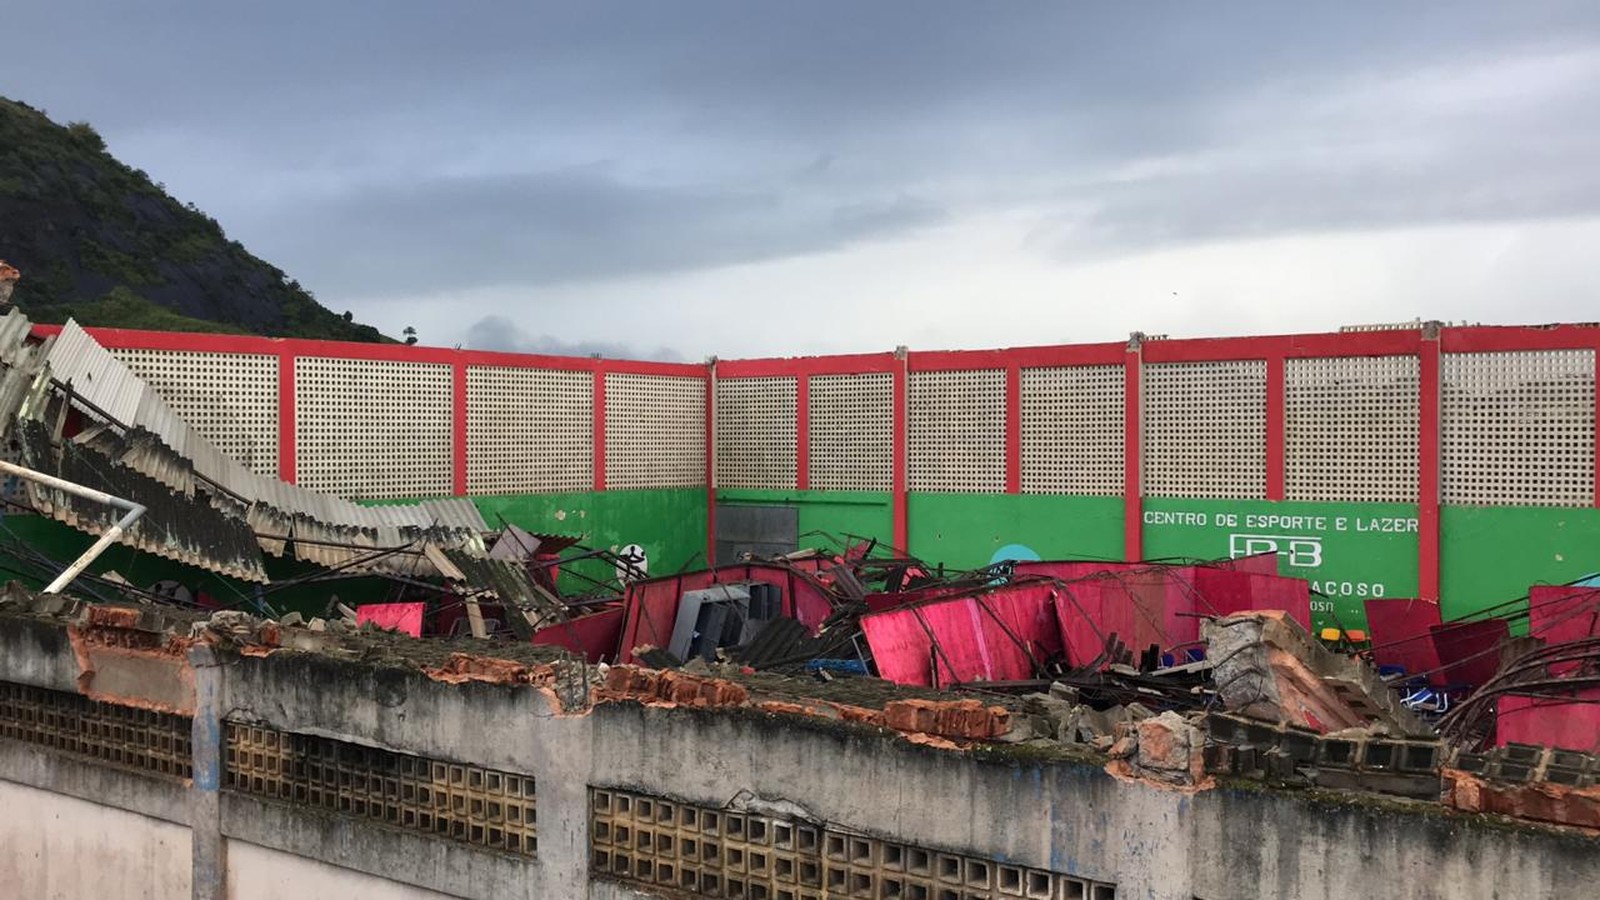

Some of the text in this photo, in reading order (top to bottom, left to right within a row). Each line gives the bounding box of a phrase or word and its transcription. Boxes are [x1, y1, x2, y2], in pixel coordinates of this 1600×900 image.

[1144, 511, 1419, 532] CENTRO DE ESPORTE E LAZER
